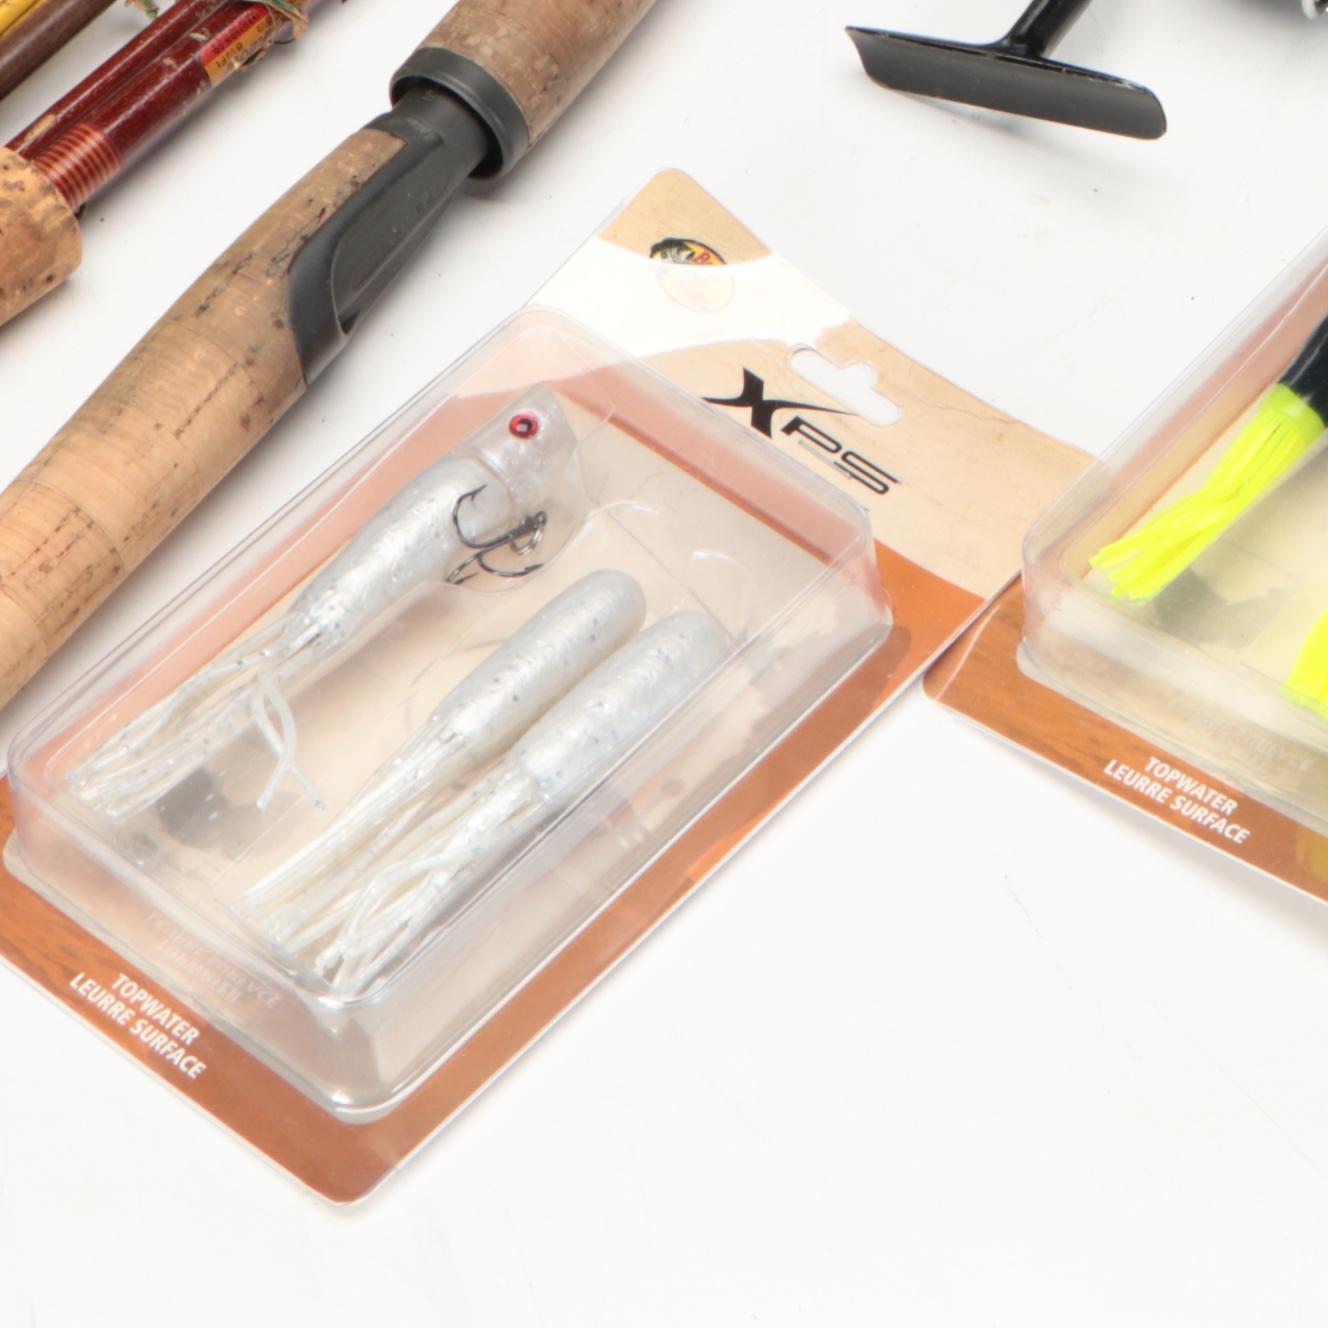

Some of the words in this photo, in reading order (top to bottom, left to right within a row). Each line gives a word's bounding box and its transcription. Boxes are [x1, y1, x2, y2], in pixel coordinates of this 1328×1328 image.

[702, 367, 902, 496] XPS
[1103, 759, 1171, 804] LEURRE
[1169, 795, 1251, 844] SURFACE
[1144, 756, 1238, 816] TOPWATER
[69, 972, 136, 1026] LEURRE
[130, 1019, 207, 1079] SURFACE
[112, 973, 200, 1046] TOPWATER
